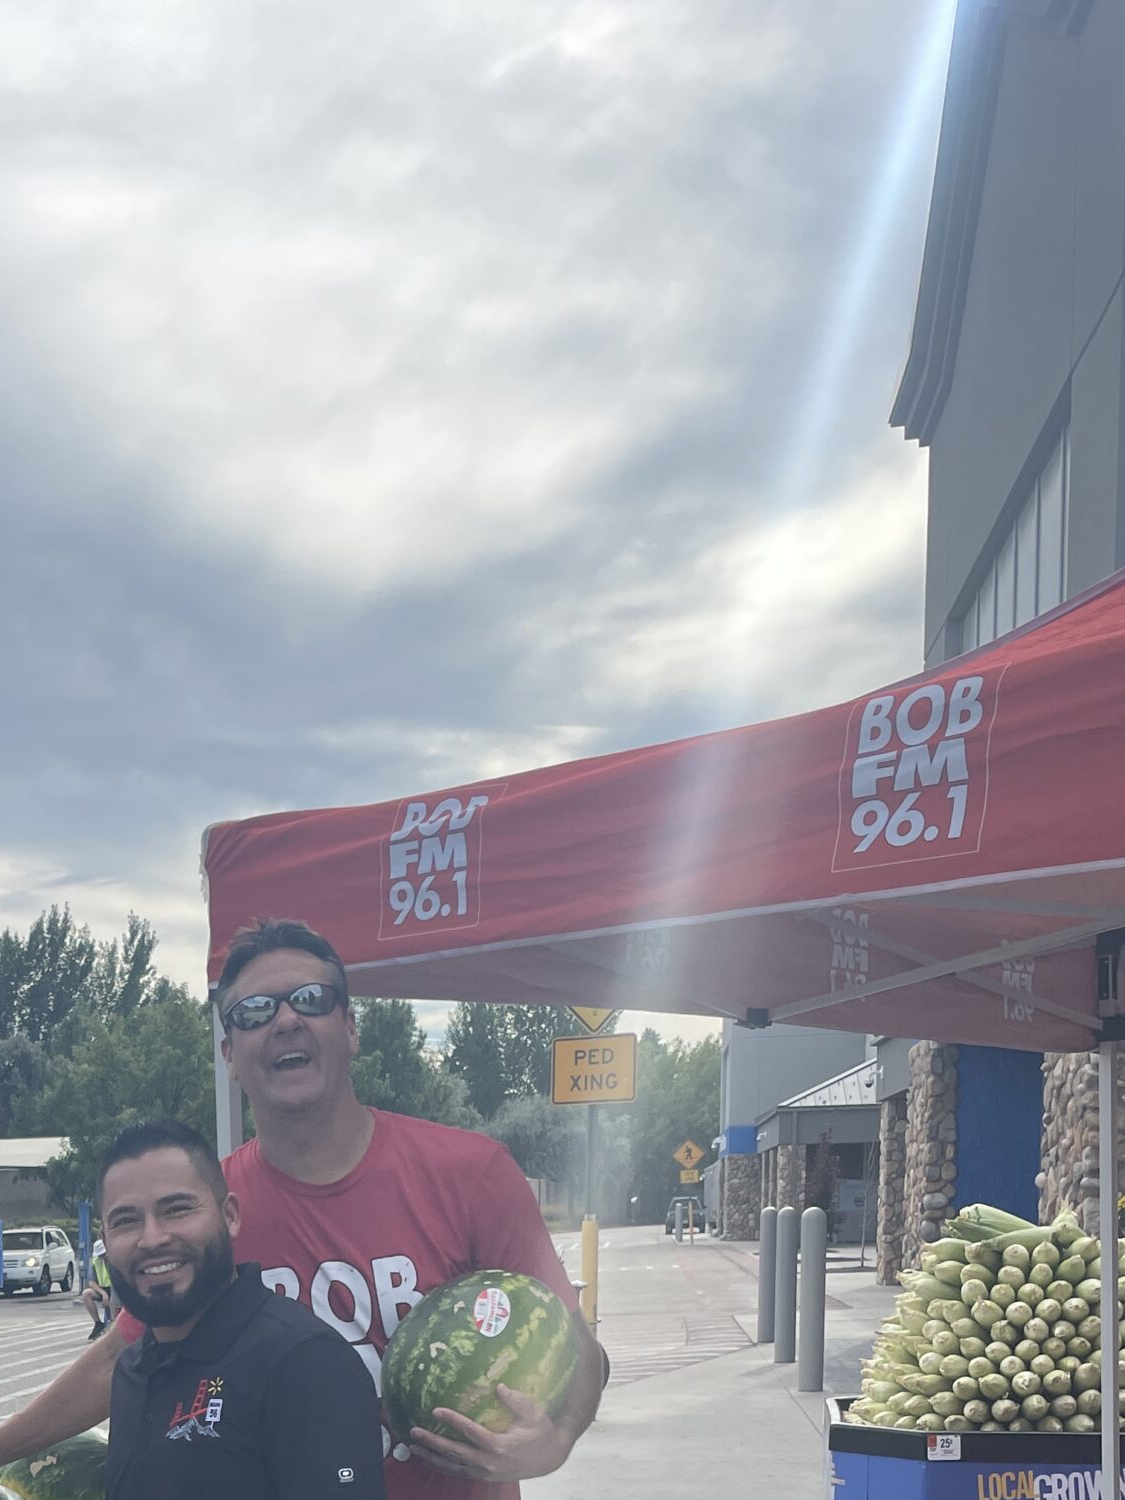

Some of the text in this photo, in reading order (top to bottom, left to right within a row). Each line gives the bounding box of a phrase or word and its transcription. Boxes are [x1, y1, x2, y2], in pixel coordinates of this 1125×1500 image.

[858, 676, 984, 755] BOB
[852, 737, 970, 799] FM
[850, 784, 968, 853] 96.1
[389, 832, 468, 880] FM
[389, 870, 467, 925] 96.1
[570, 1073, 618, 1092] XING
[574, 1048, 615, 1066] PED
